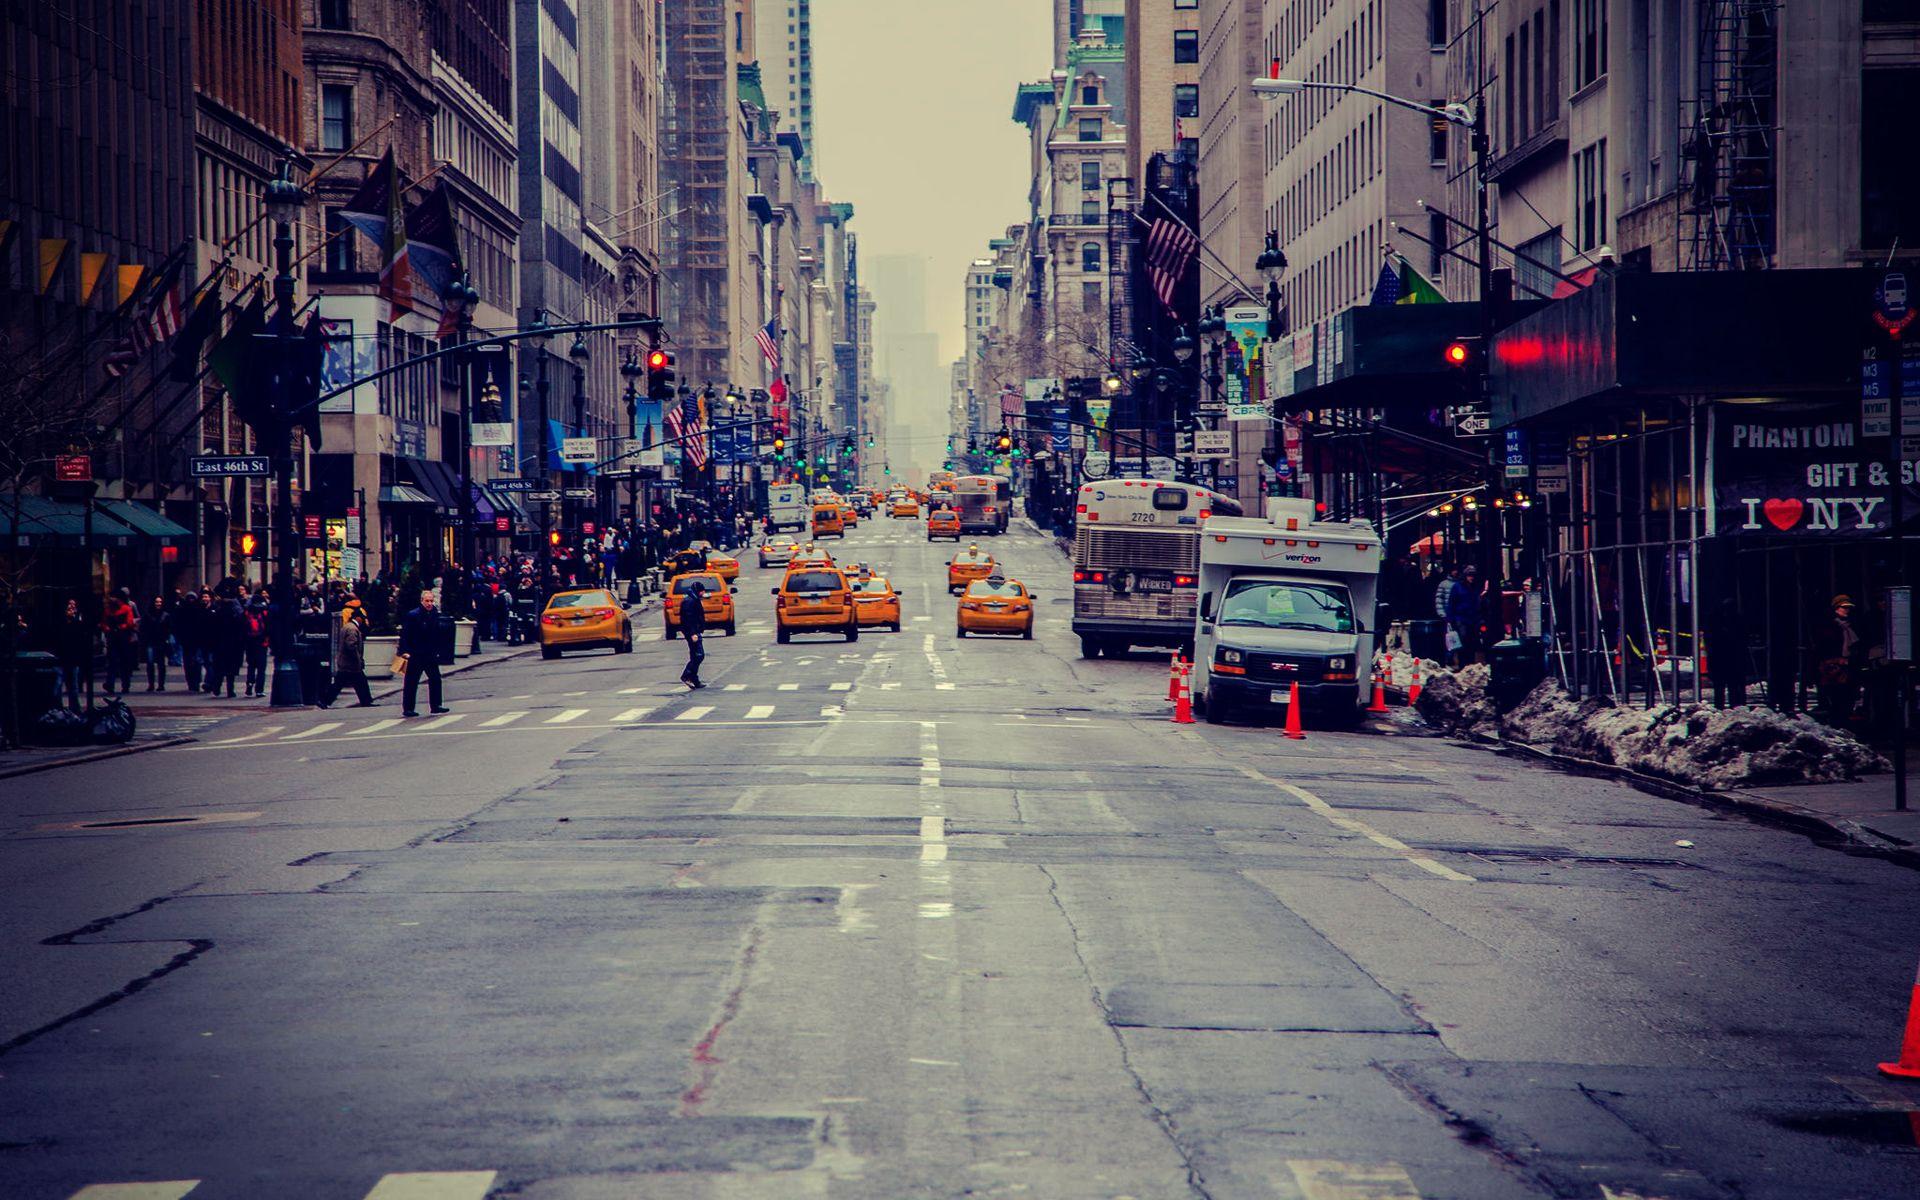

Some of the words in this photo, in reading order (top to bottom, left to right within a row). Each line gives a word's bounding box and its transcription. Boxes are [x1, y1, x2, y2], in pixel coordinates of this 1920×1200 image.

[1863, 363, 1878, 377] M3
[1863, 382, 1879, 396] M5
[1465, 420, 1485, 429] ONE
[1732, 423, 1855, 448] PHANTOM
[1506, 443, 1519, 452] M4
[196, 462, 222, 472] East
[223, 461, 249, 471] 46th
[251, 460, 264, 471] St
[1806, 463, 1859, 487] GIFT
[1868, 461, 1890, 486] &
[1132, 512, 1155, 522] 2720
[1740, 498, 1763, 529] I
[1285, 553, 1321, 564] verizon
